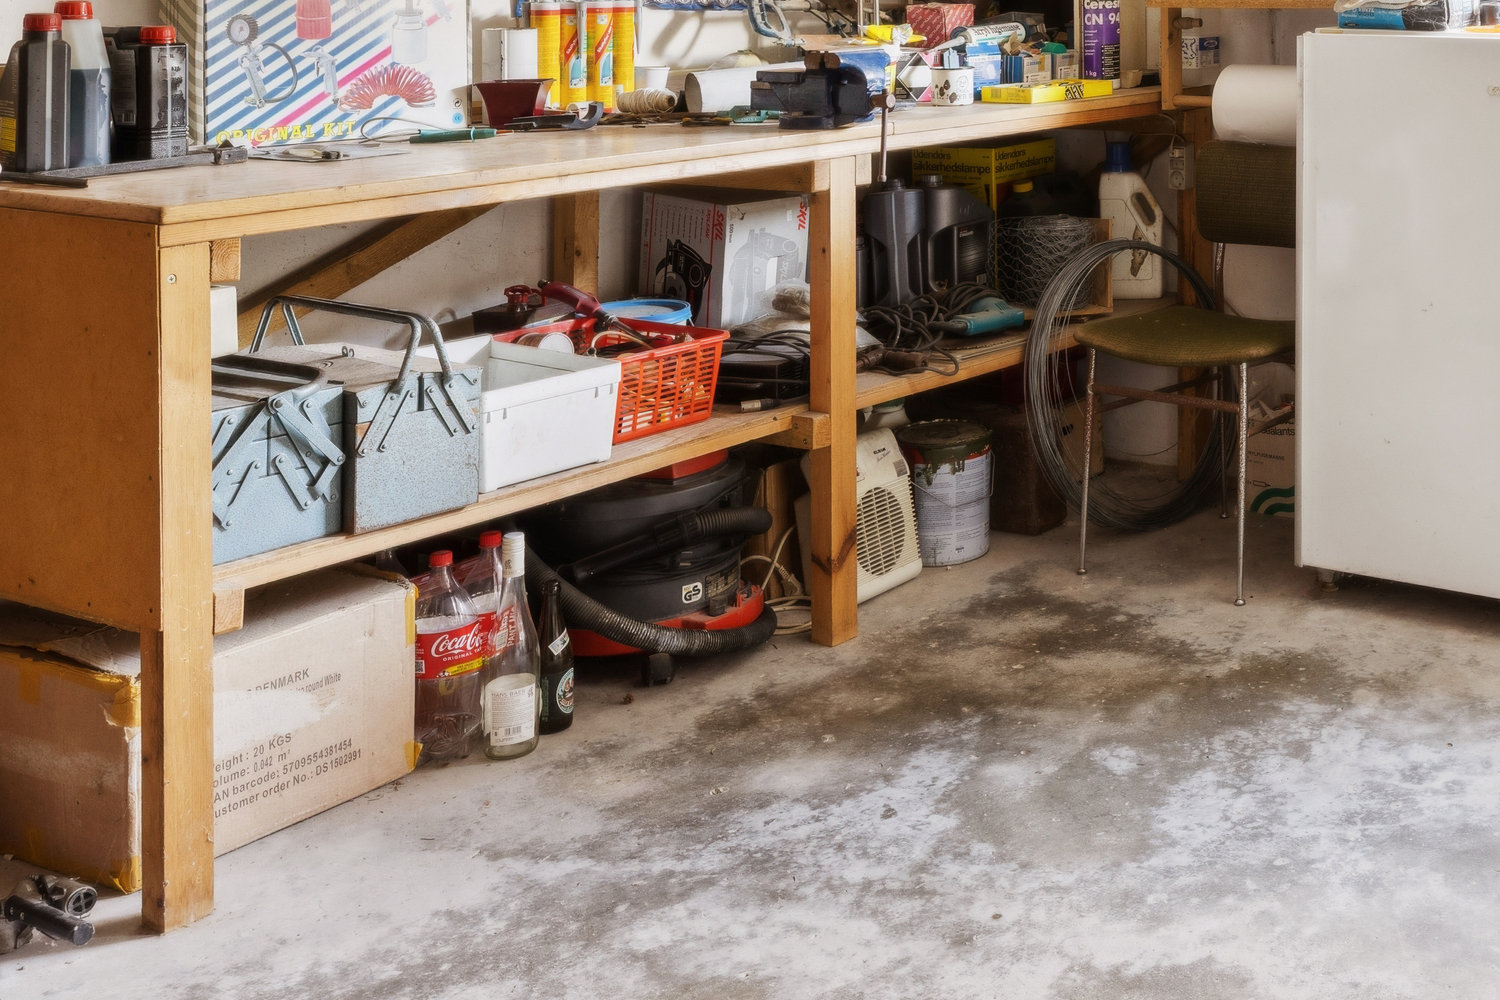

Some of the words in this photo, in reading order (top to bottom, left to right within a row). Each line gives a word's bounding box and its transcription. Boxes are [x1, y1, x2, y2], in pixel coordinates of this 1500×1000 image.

[1085, 13, 1103, 25] CN
[323, 120, 356, 136] KIT
[715, 210, 724, 241] SKIL
[797, 202, 808, 231] SKIL
[443, 652, 473, 661] ORIGINAL
[306, 677, 324, 692] round
[324, 672, 342, 686] White
[214, 753, 243, 772] eight
[253, 744, 264, 758] 20
[269, 733, 292, 750] KGS
[213, 788, 229, 804] AN
[232, 769, 279, 795] barcode:
[282, 738, 352, 775] 5709554381454
[213, 766, 249, 788] olume:
[253, 756, 273, 772] 0.042
[215, 792, 260, 818] ustomer
[263, 780, 290, 798] order
[293, 771, 313, 786] No.:
[316, 749, 361, 776] DS1502991
